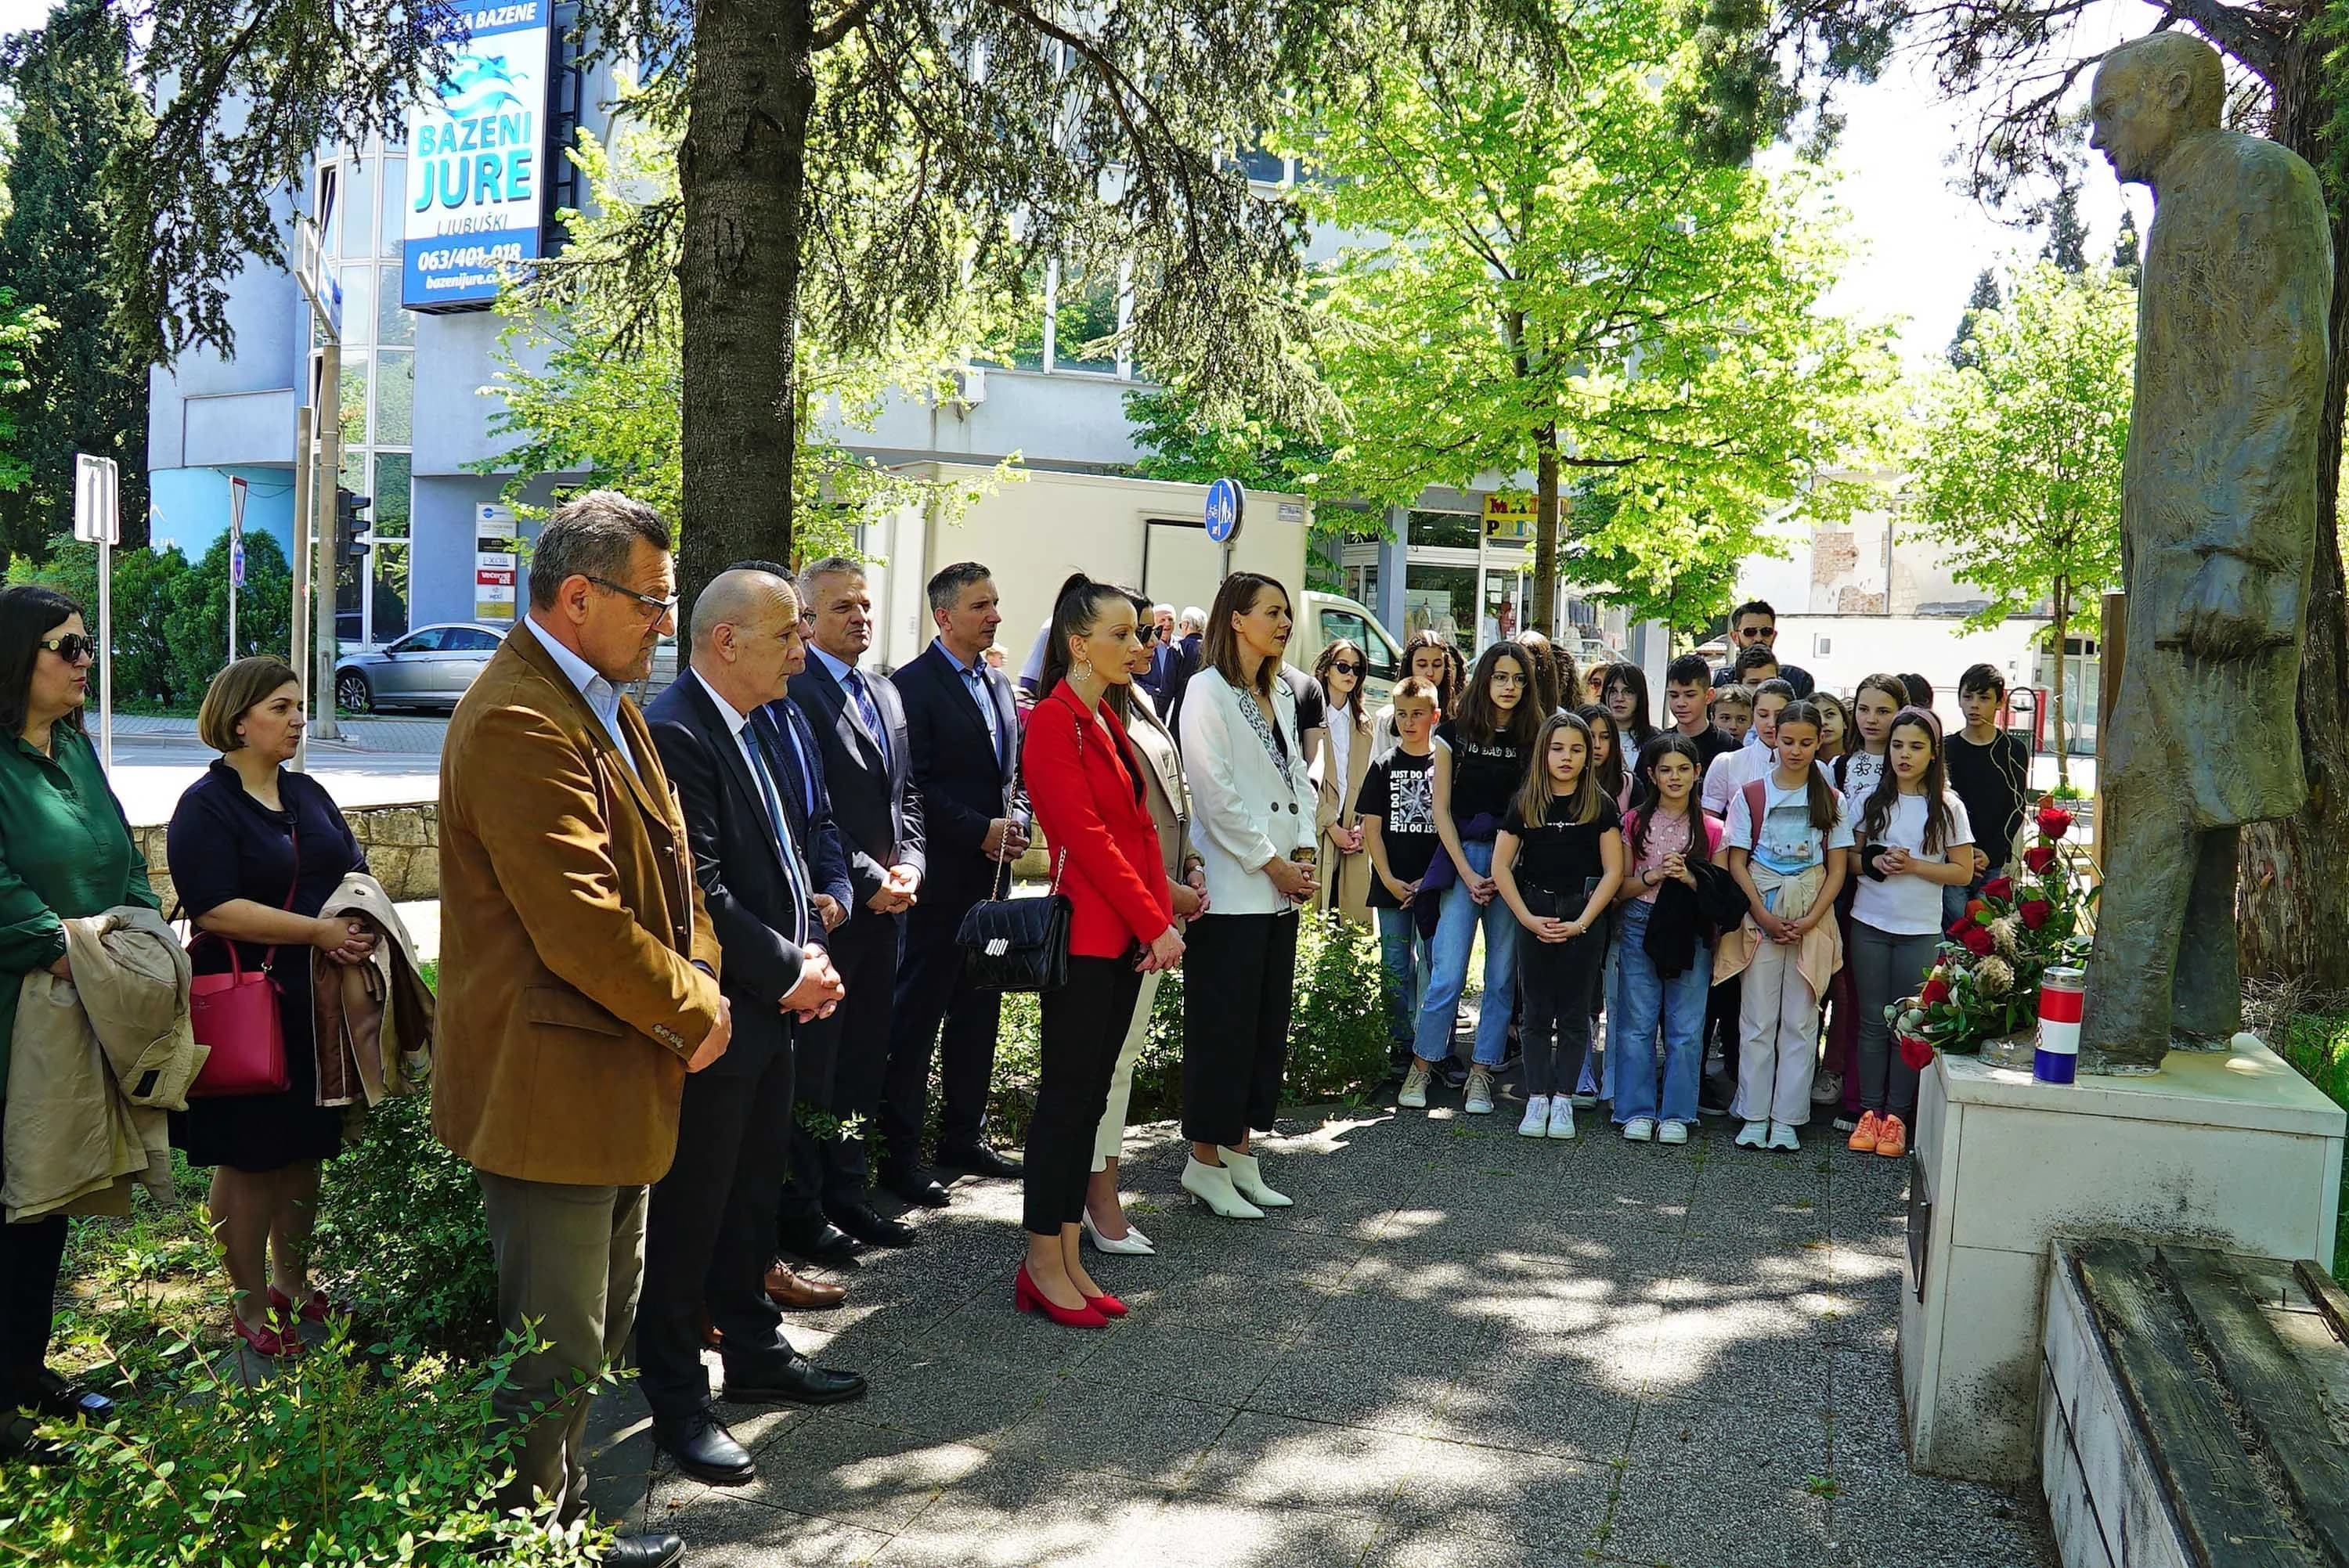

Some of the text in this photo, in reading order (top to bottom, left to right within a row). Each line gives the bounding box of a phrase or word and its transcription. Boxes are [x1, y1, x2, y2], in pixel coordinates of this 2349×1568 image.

[475, 2, 537, 29] BAZENE
[417, 111, 532, 157] BAZENI
[413, 150, 533, 213] JURE
[1485, 520, 1539, 535] PRIN
[1390, 770, 1409, 779] JUST
[1410, 770, 1423, 779] DO
[1390, 793, 1400, 808] DO
[1409, 824, 1422, 833] DO
